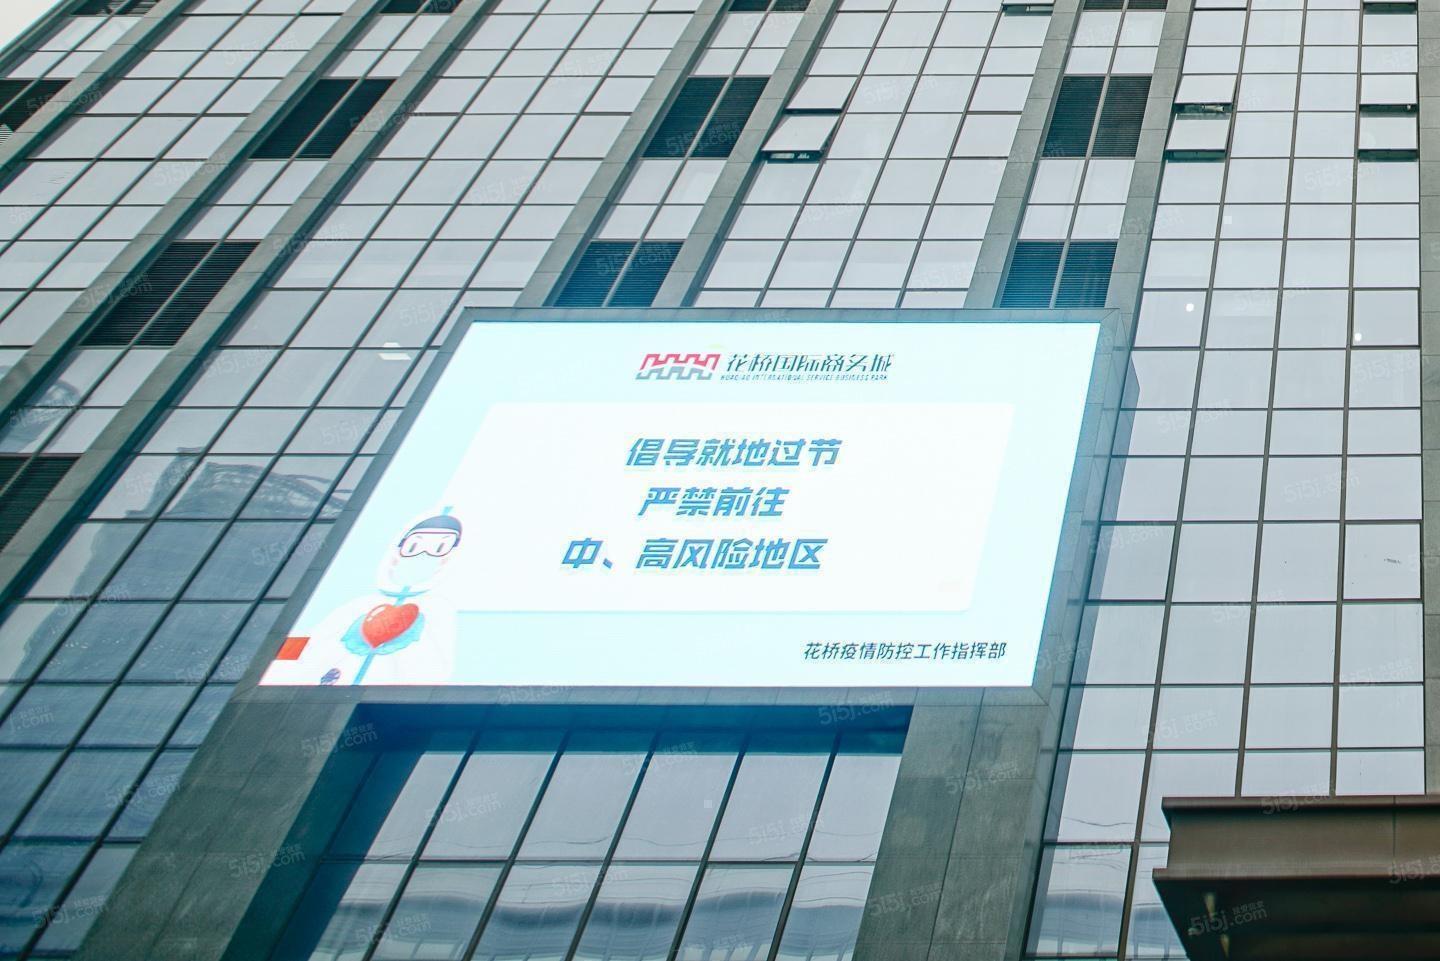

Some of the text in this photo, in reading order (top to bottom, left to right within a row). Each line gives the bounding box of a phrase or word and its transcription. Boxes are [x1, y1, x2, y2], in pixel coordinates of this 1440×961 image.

[625, 437, 843, 467] 倡导就地过节
[637, 486, 790, 517] 严禁前往
[561, 537, 829, 570] 中、高风险地区
[803, 641, 1008, 661] 花桥疫情防控工作指挥部
